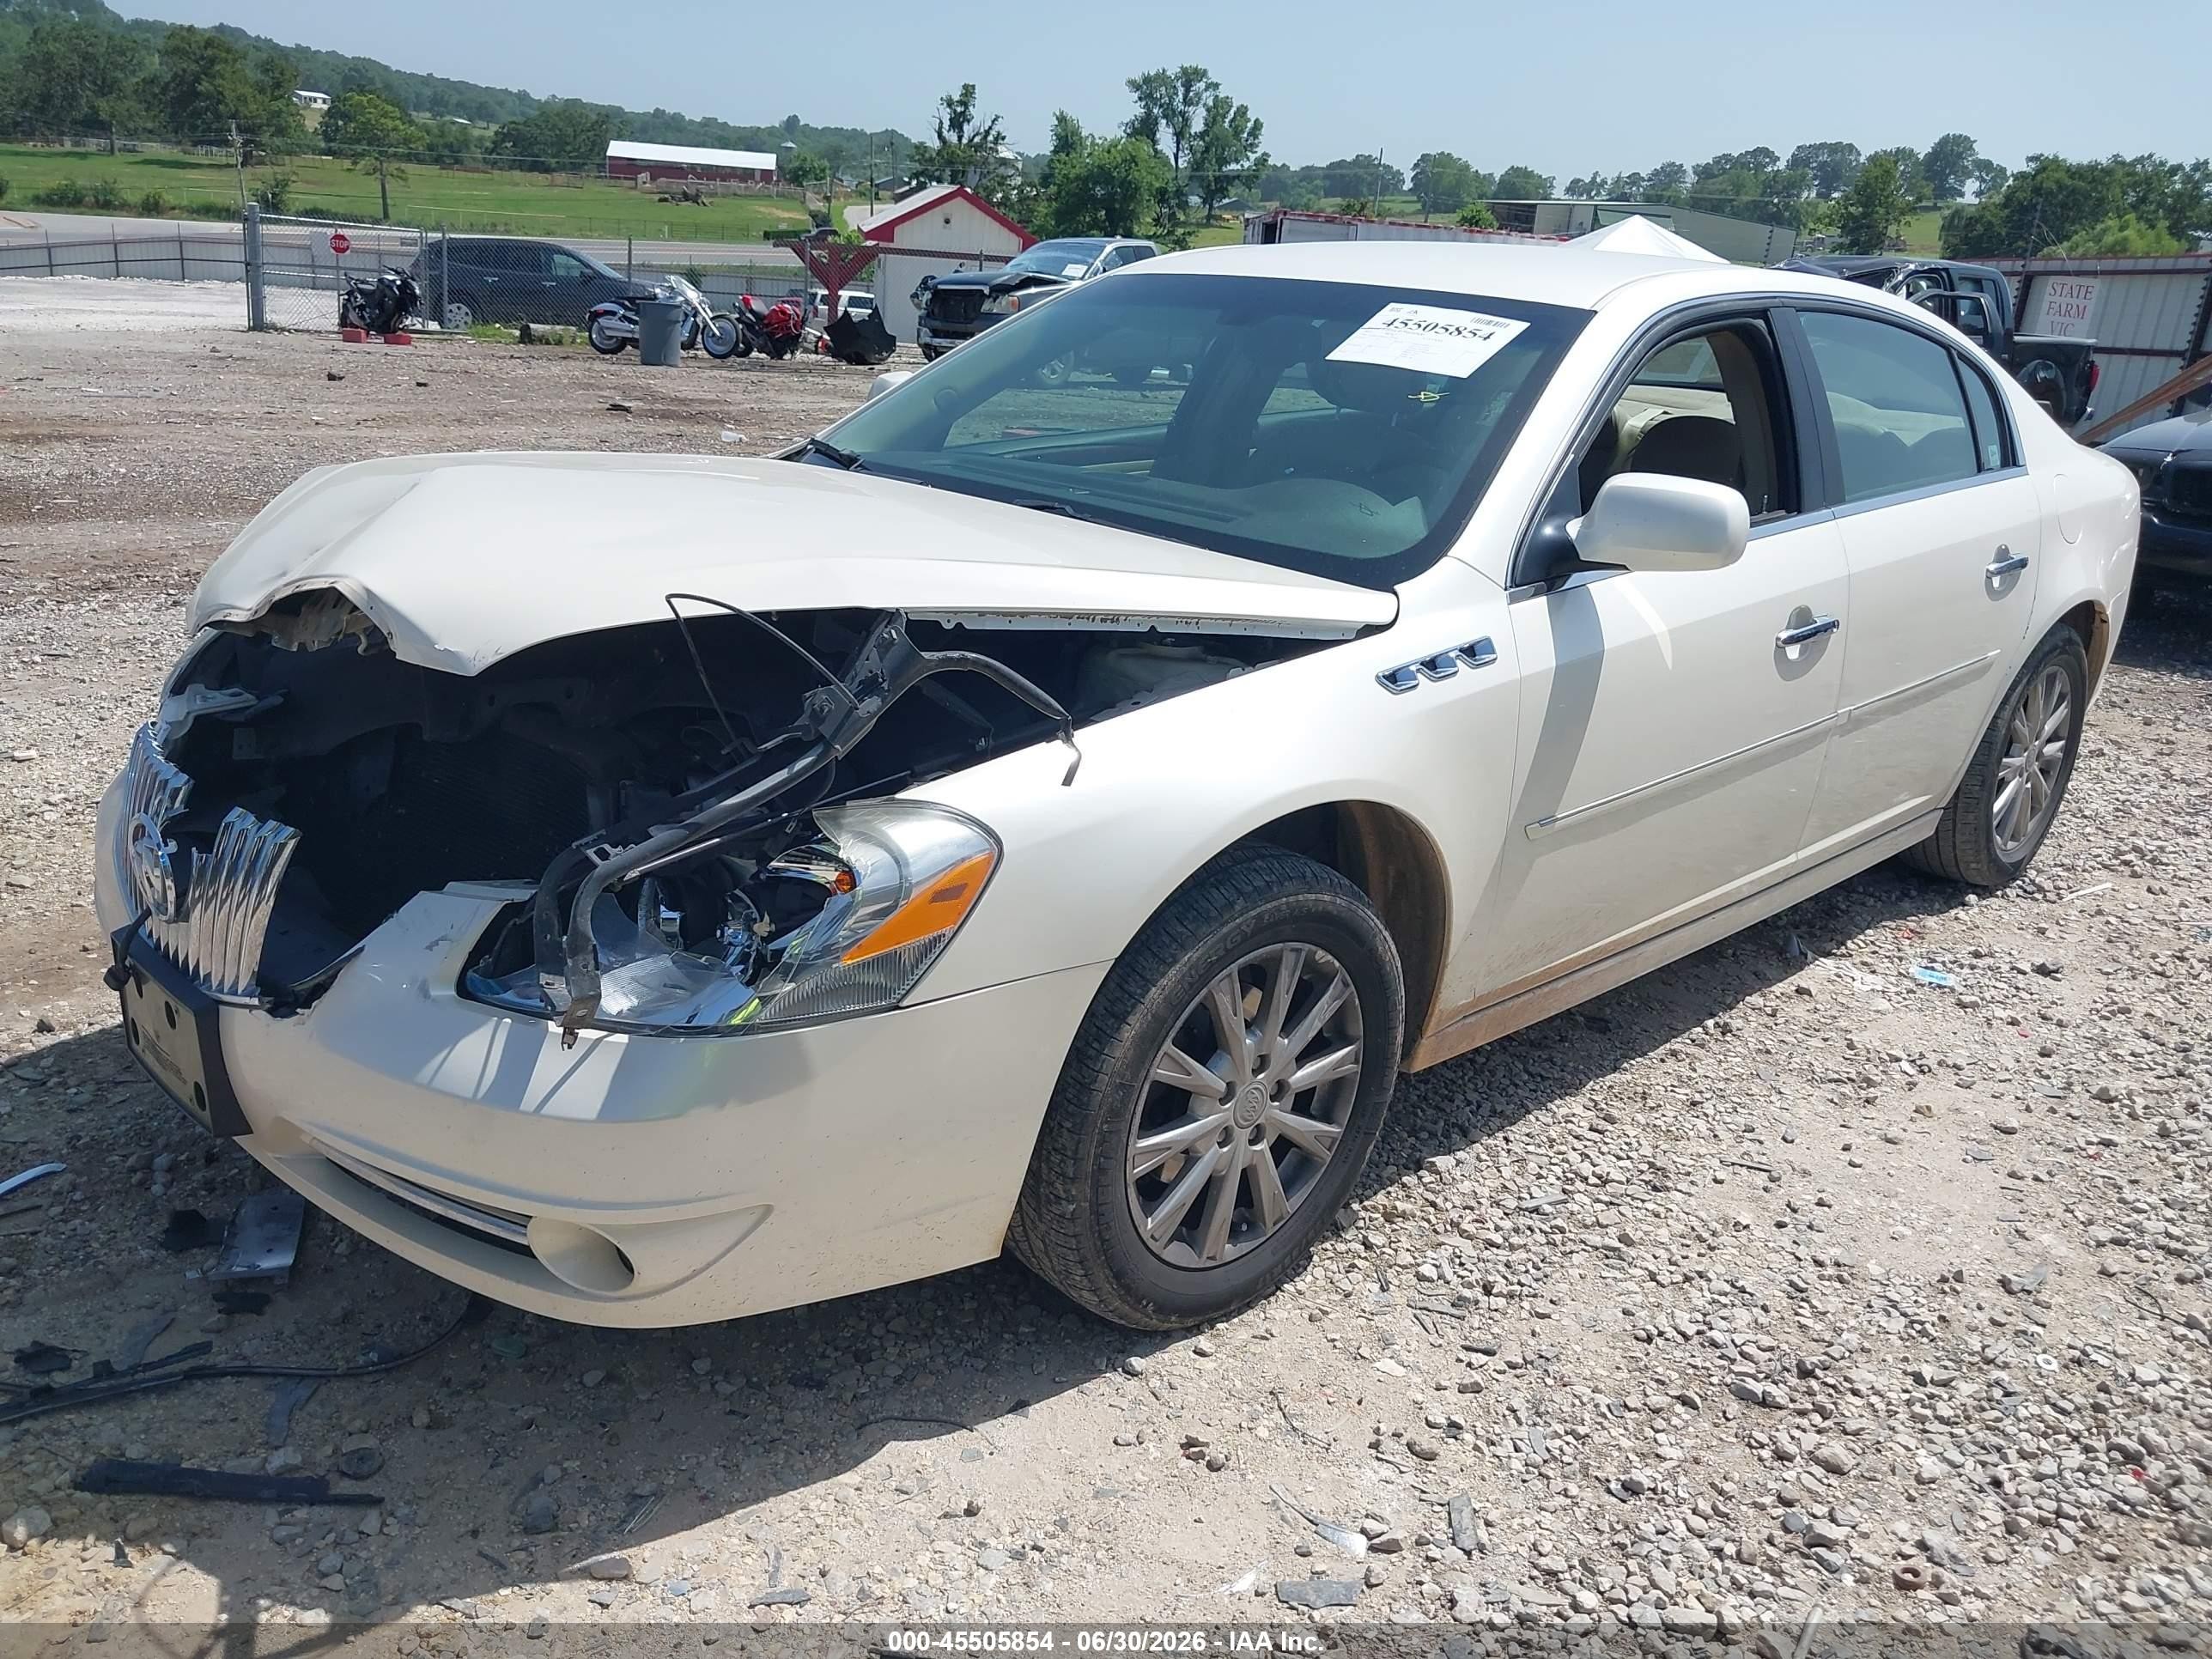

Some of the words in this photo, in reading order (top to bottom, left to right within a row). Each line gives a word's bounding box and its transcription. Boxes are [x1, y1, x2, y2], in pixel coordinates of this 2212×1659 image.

[330, 239, 349, 249] STOP
[2049, 281, 2095, 301] STATE
[2046, 301, 2087, 320] FARM
[1382, 317, 1496, 341] 45505854
[2051, 320, 2075, 337] VIC
